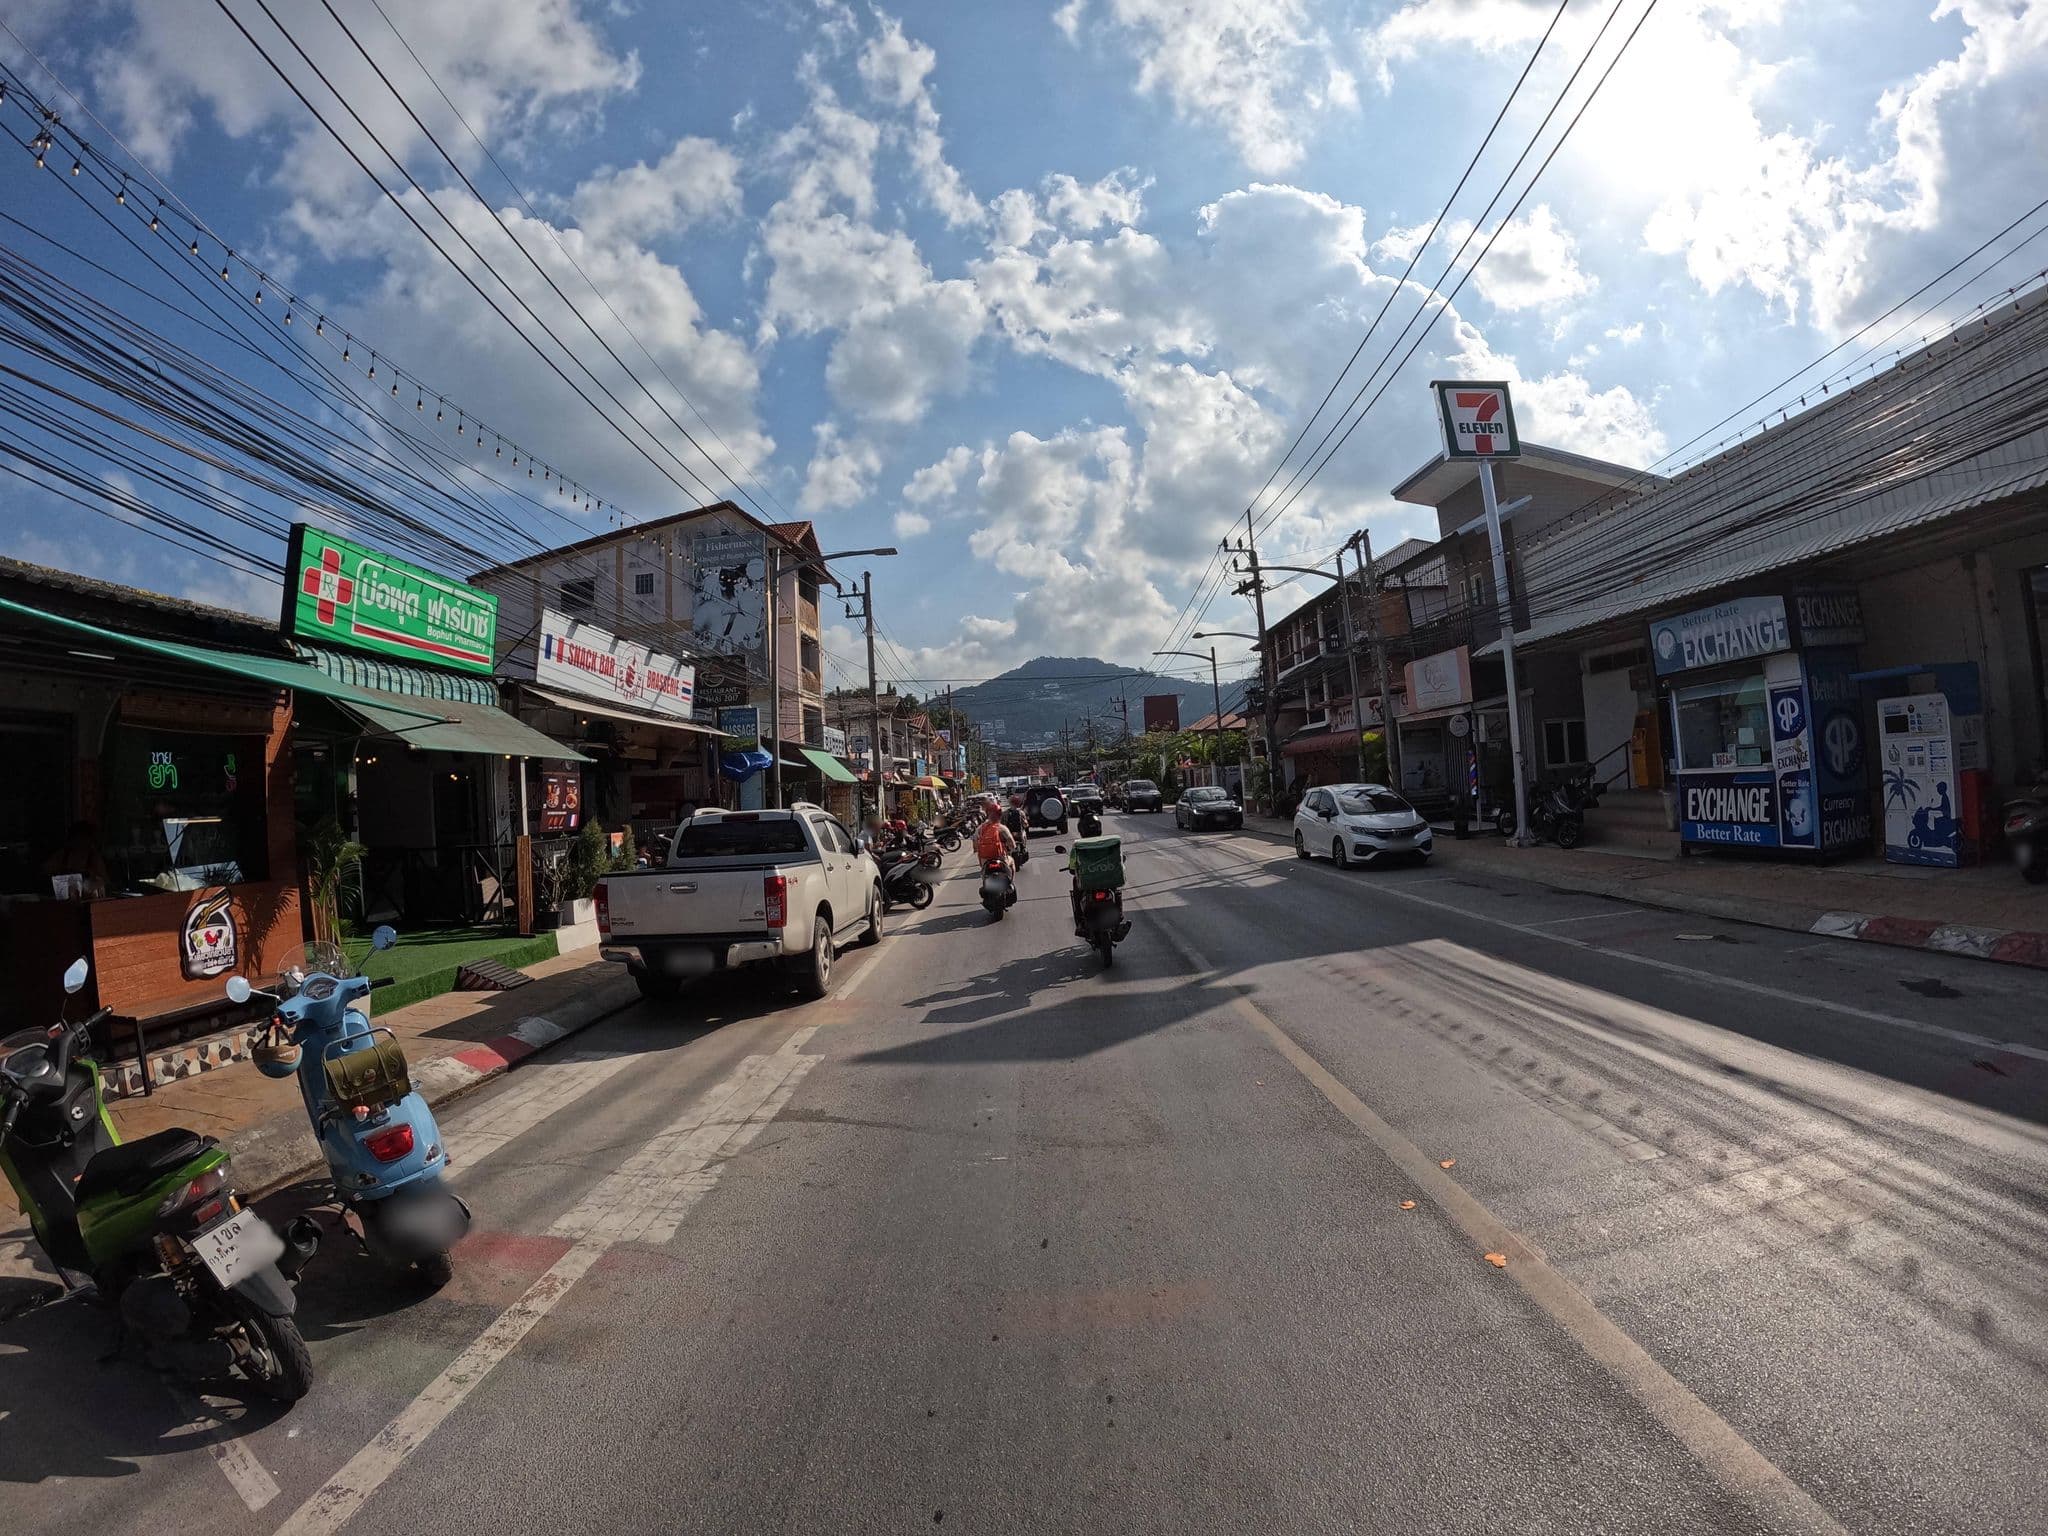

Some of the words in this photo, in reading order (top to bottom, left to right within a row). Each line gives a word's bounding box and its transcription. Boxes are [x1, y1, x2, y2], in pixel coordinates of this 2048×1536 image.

[362, 570, 419, 625] บ่อพุด
[1798, 596, 1859, 627] EXCHANGE
[1681, 614, 1711, 628] Better
[1715, 606, 1739, 619] Rate
[427, 625, 452, 641] Bophut
[454, 634, 486, 652] Pharmacy
[1681, 608, 1786, 667] EXCHANGE
[568, 643, 598, 671] SNACK
[599, 654, 616, 677] BAR
[647, 669, 680, 696] BRASSERIE
[1687, 787, 1770, 823] EXCHANGE
[1823, 798, 1856, 813] Currency
[1697, 823, 1731, 841] Better
[1733, 825, 1761, 842] Rate
[1088, 856, 1115, 873] Grab
